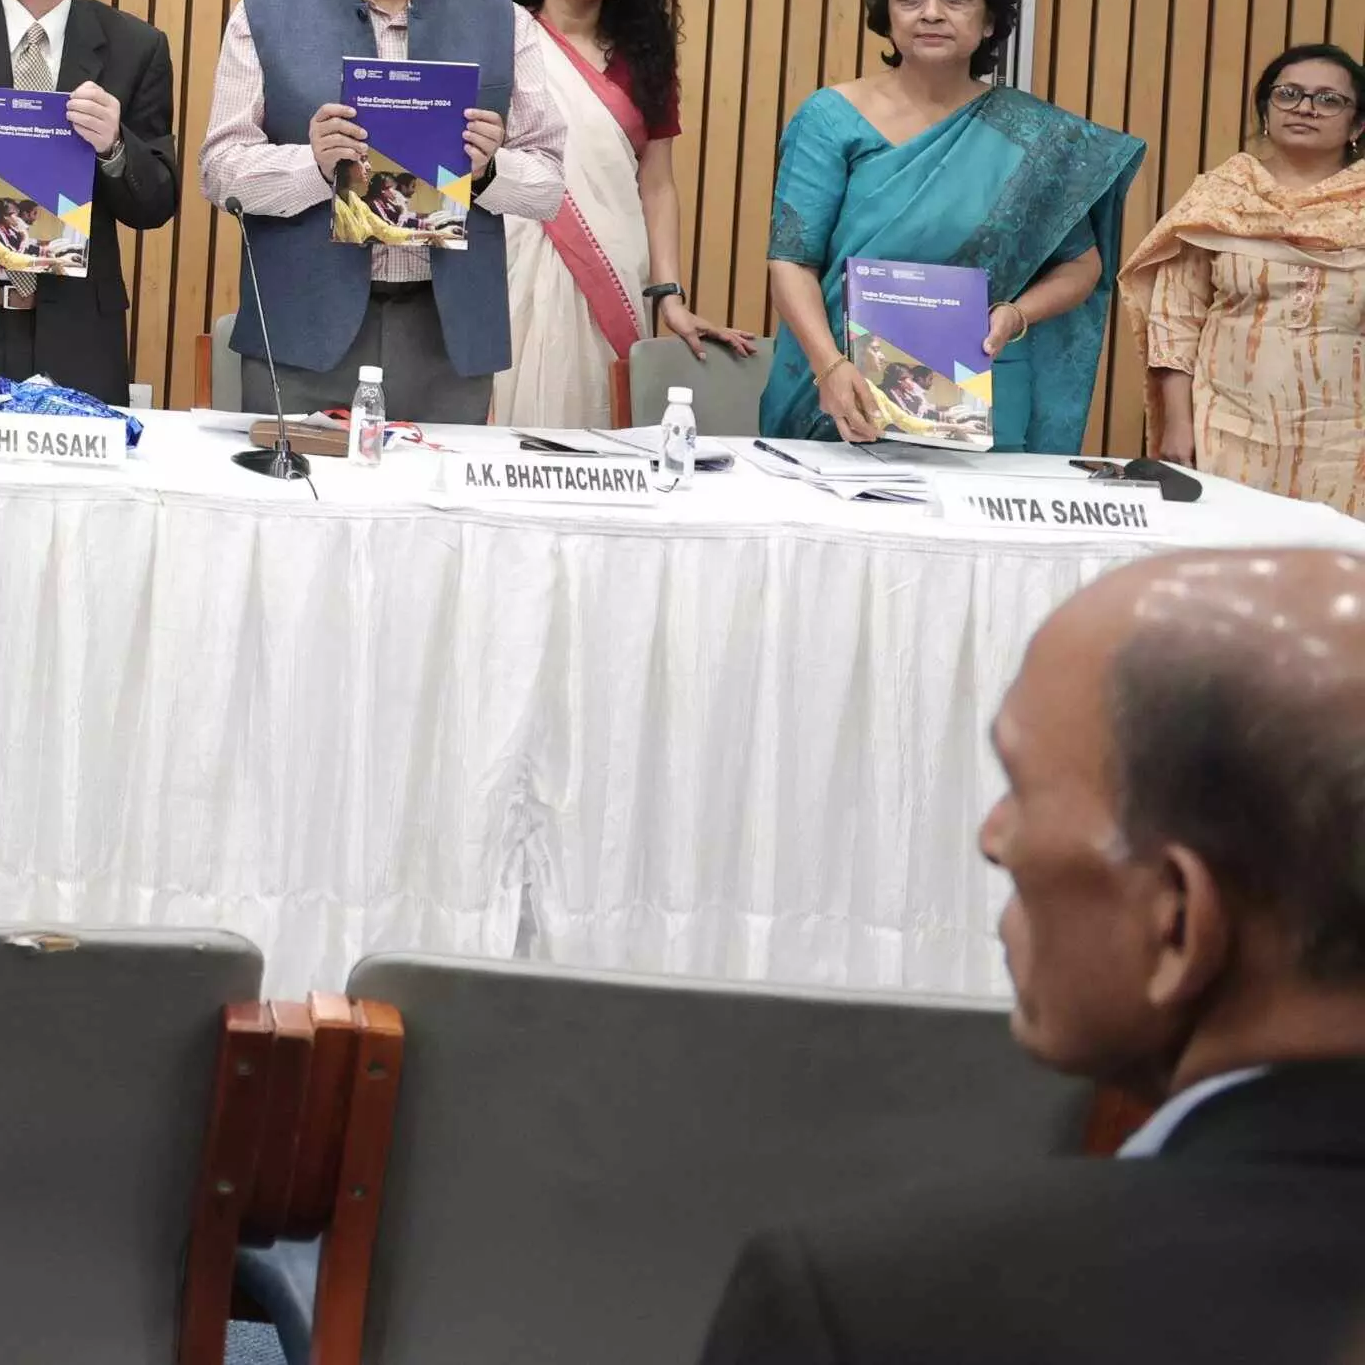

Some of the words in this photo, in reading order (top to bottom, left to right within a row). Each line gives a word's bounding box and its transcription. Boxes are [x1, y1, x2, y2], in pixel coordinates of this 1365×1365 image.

[26, 430, 107, 459] SASAKI
[465, 462, 501, 487] A.K.
[504, 463, 649, 493] BHATTACHARYA
[1051, 499, 1148, 528] SANGHI
